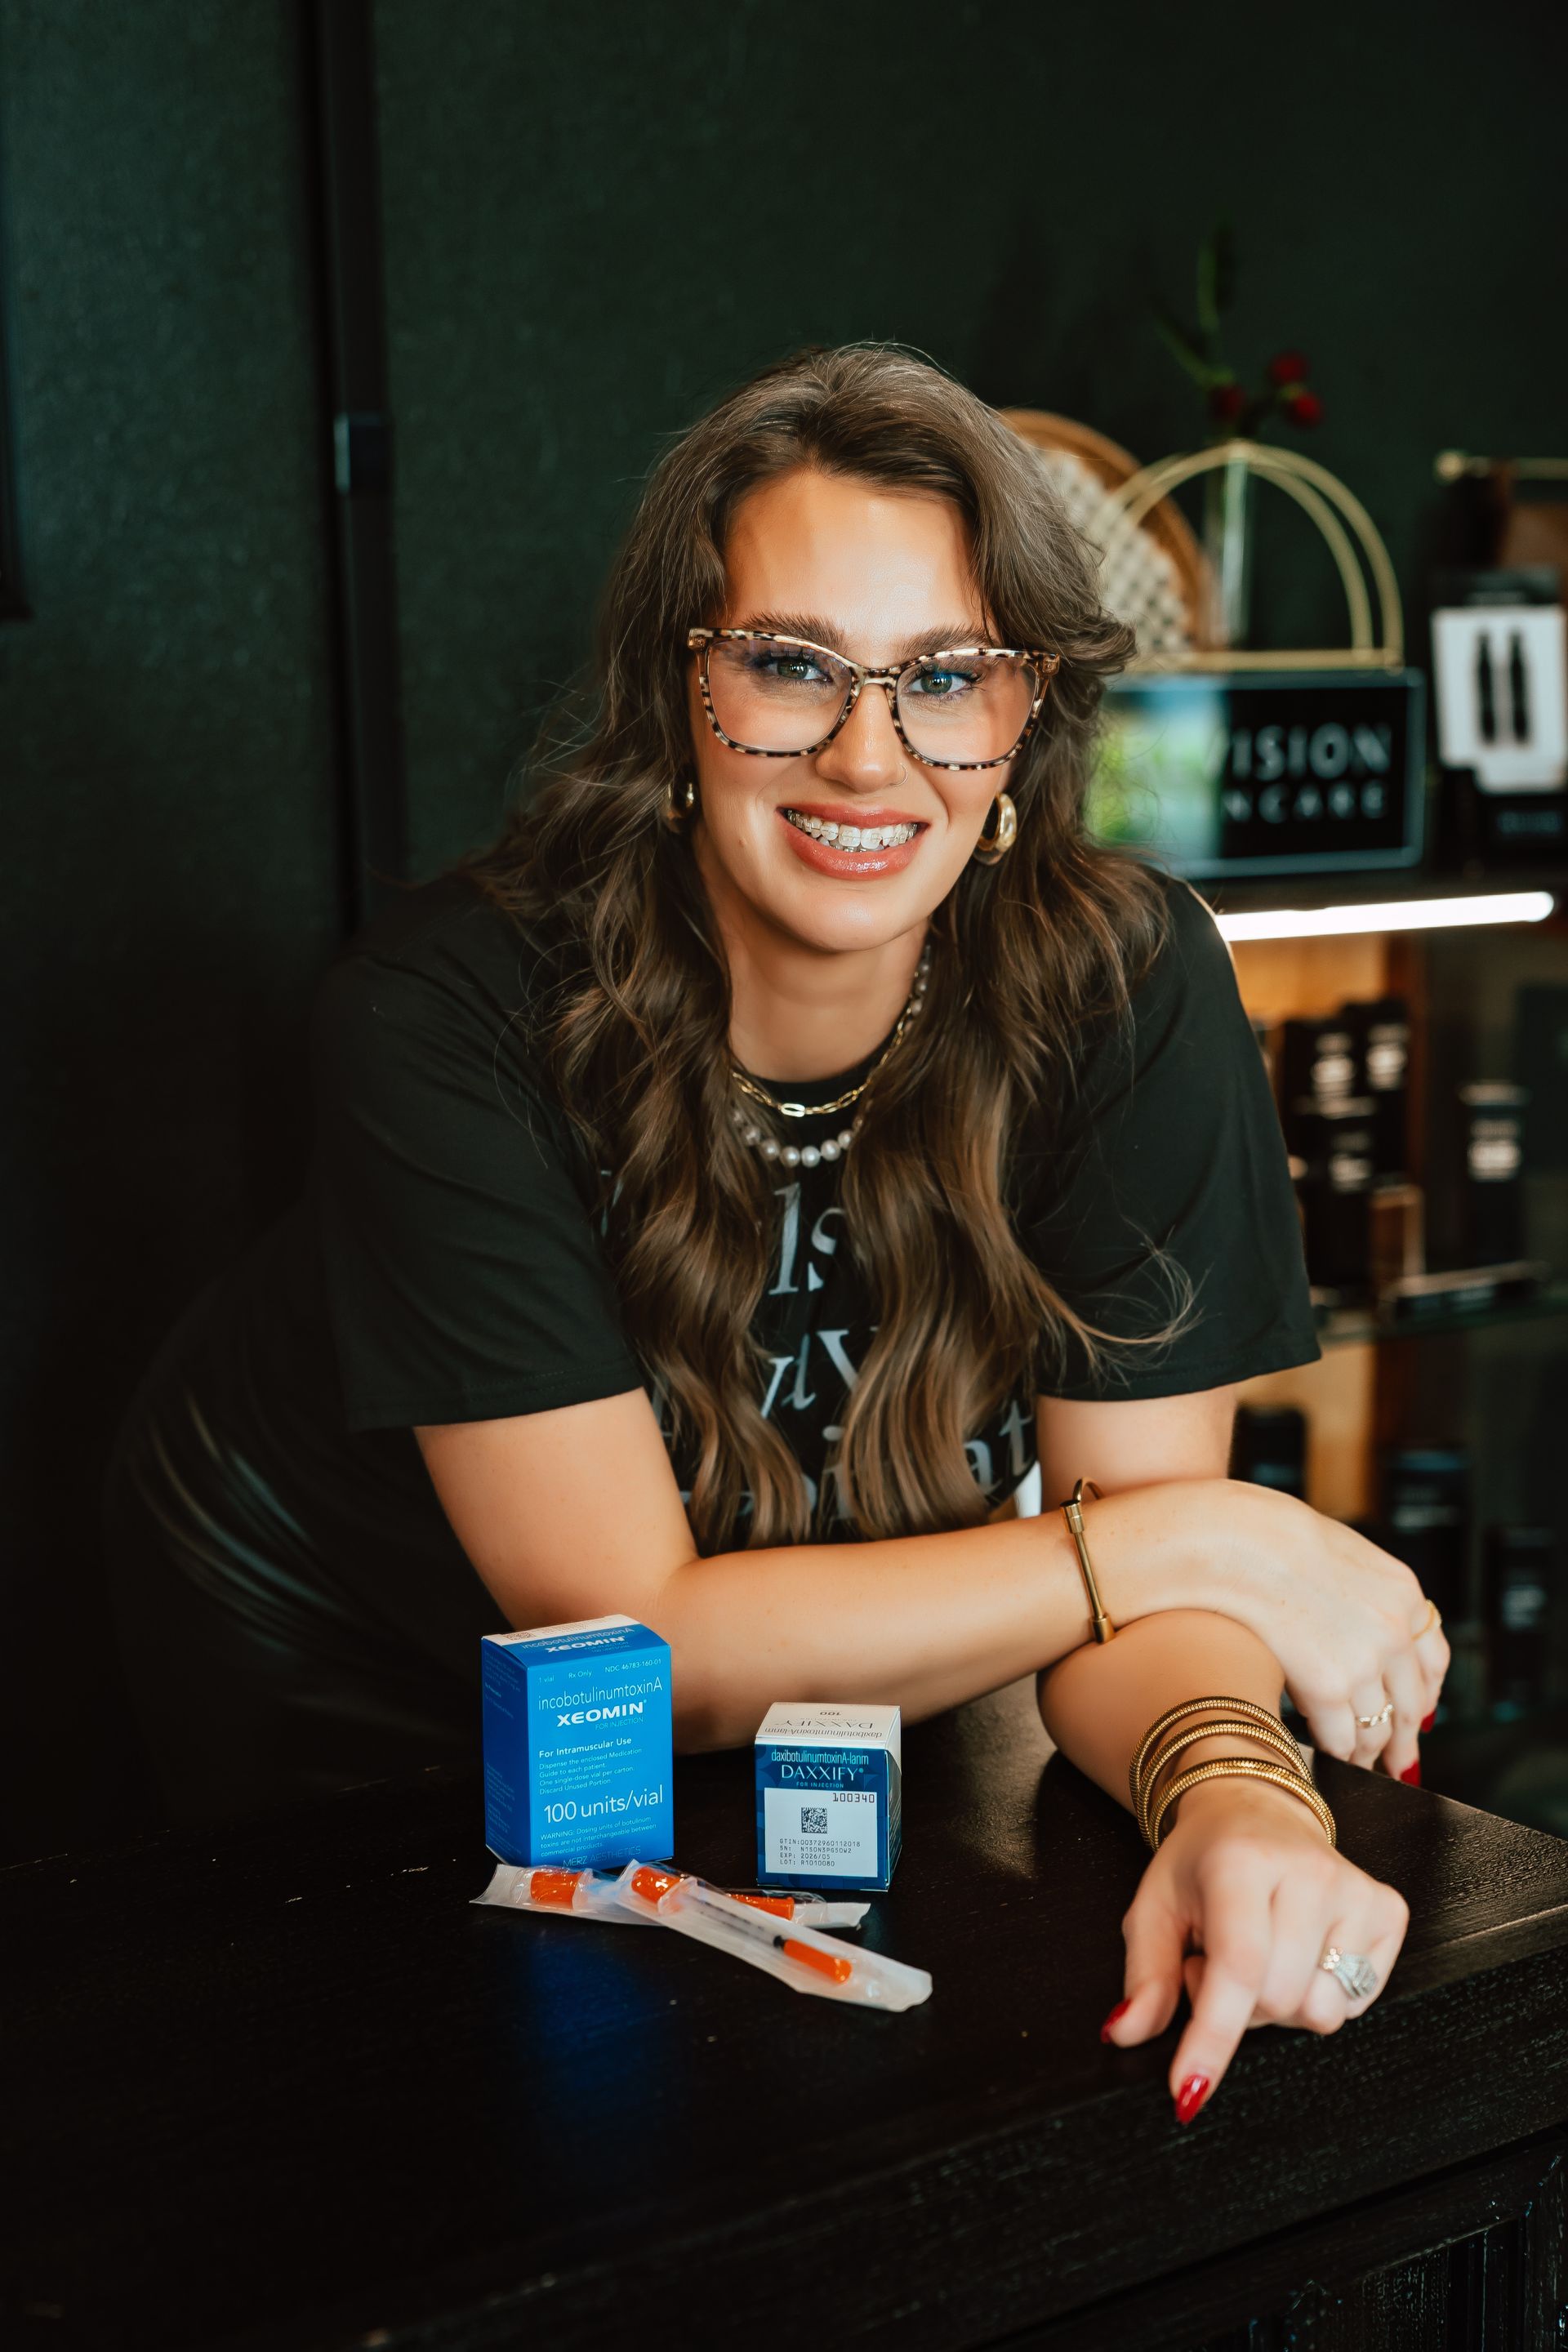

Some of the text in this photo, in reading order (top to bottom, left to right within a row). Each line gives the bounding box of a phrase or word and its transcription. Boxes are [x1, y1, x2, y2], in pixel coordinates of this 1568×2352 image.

[577, 1669, 592, 1678] Only
[604, 1665, 620, 1673] NDC
[538, 1676, 662, 1710] incobotulinumtoxinA
[595, 1716, 644, 1731] FOR INJECTION
[539, 1737, 632, 1758] For Intramuscular Use
[539, 1760, 568, 1771] Dispense
[581, 1753, 608, 1764] enclosed
[609, 1747, 642, 1758] Medication
[771, 1748, 869, 1765] daxibotulinumtoxinA-lanm
[539, 1770, 558, 1779] Guide
[568, 1766, 582, 1774] each
[555, 1771, 589, 1785] single-dose
[591, 1769, 601, 1778] vial
[603, 1769, 613, 1778] per
[539, 1784, 563, 1795] Discard
[564, 1782, 587, 1793] Unused
[544, 1801, 577, 1824] 100
[581, 1784, 663, 1818] units/vial
[833, 1792, 875, 1803] 100340
[577, 1825, 598, 1836] Dosing
[599, 1823, 613, 1832] units
[614, 1820, 621, 1829] of
[621, 1815, 652, 1828] botulinum
[541, 1841, 559, 1850] toxins
[572, 1836, 582, 1845] not
[631, 1823, 657, 1833] between
[541, 1847, 576, 1858] commercial
[563, 1846, 641, 1868] MERZ AESTHETICS
